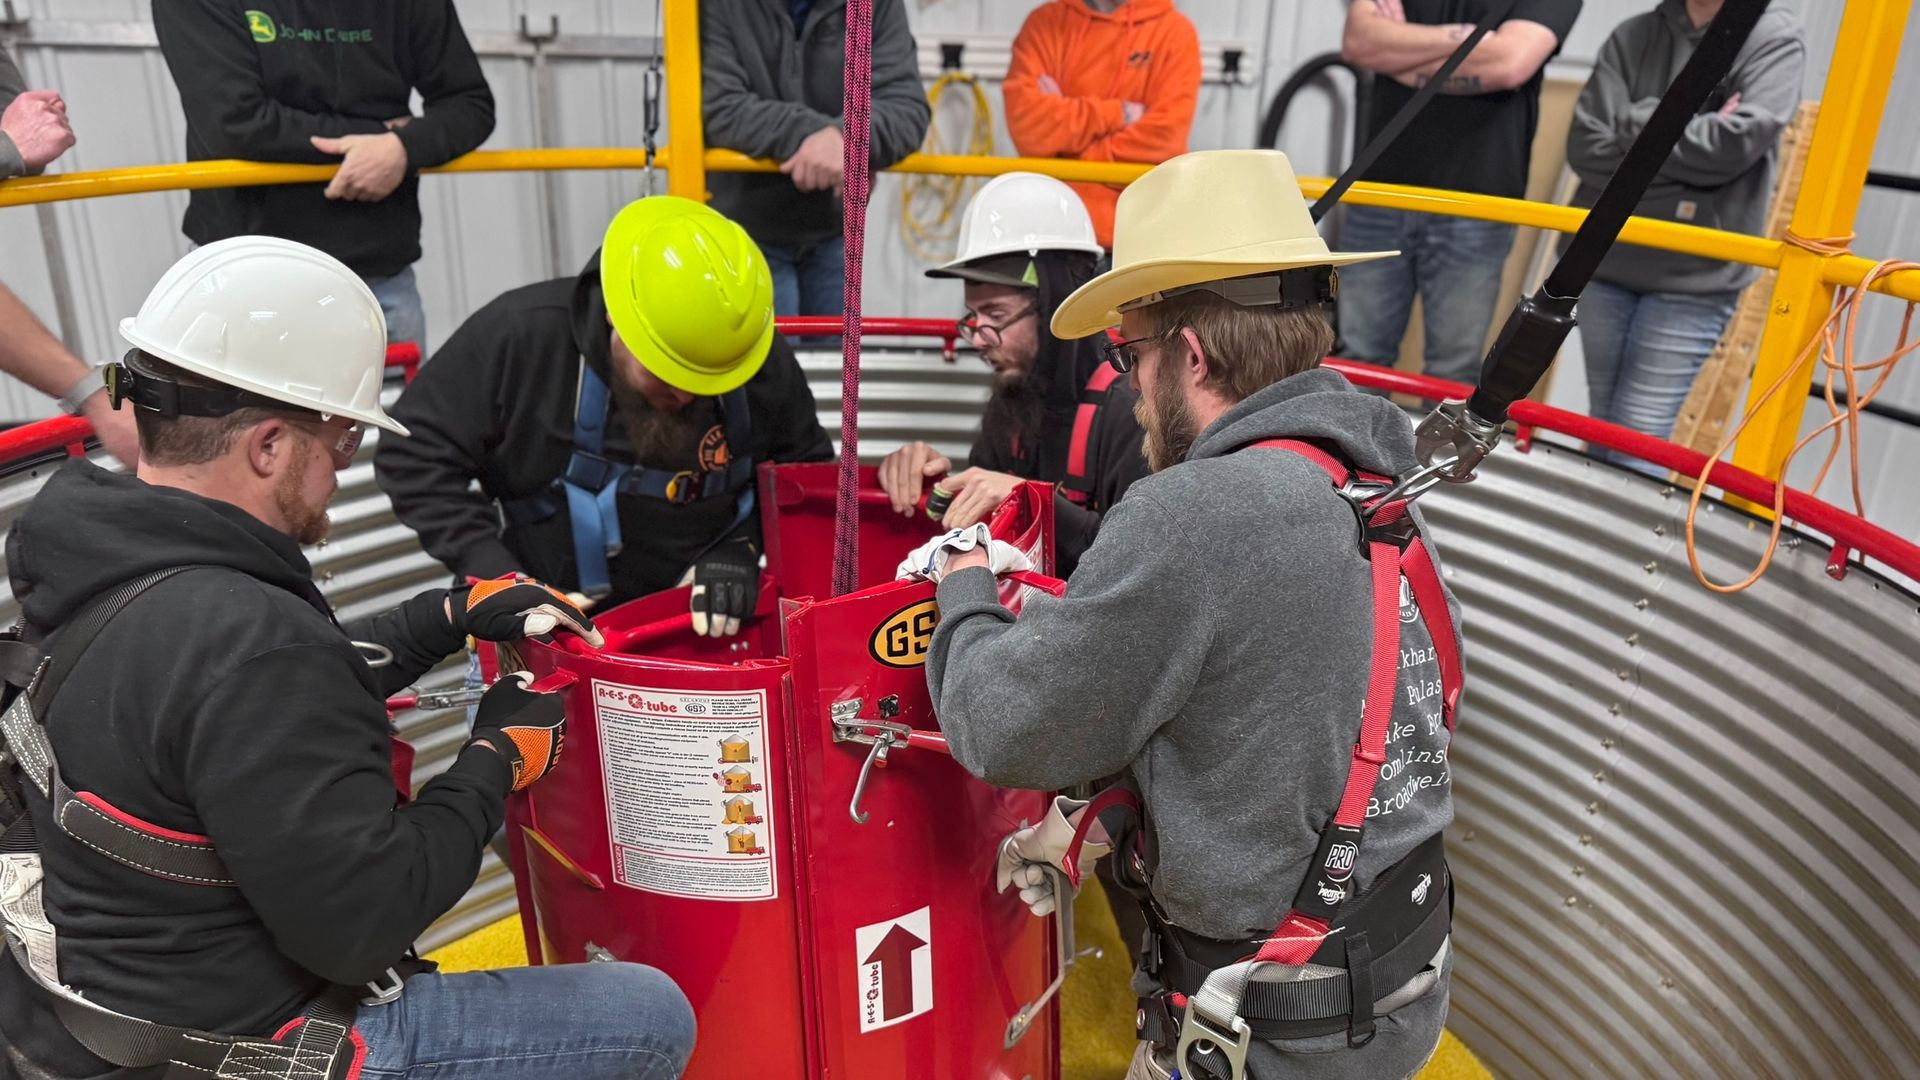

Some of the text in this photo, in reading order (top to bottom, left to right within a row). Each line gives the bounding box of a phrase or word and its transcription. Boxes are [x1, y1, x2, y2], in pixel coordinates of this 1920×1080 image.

[887, 610, 936, 657] GS
[1397, 646, 1434, 668] khar
[1407, 680, 1441, 705] Pulas
[1381, 746, 1448, 780] omlins
[1325, 844, 1356, 870] PRO
